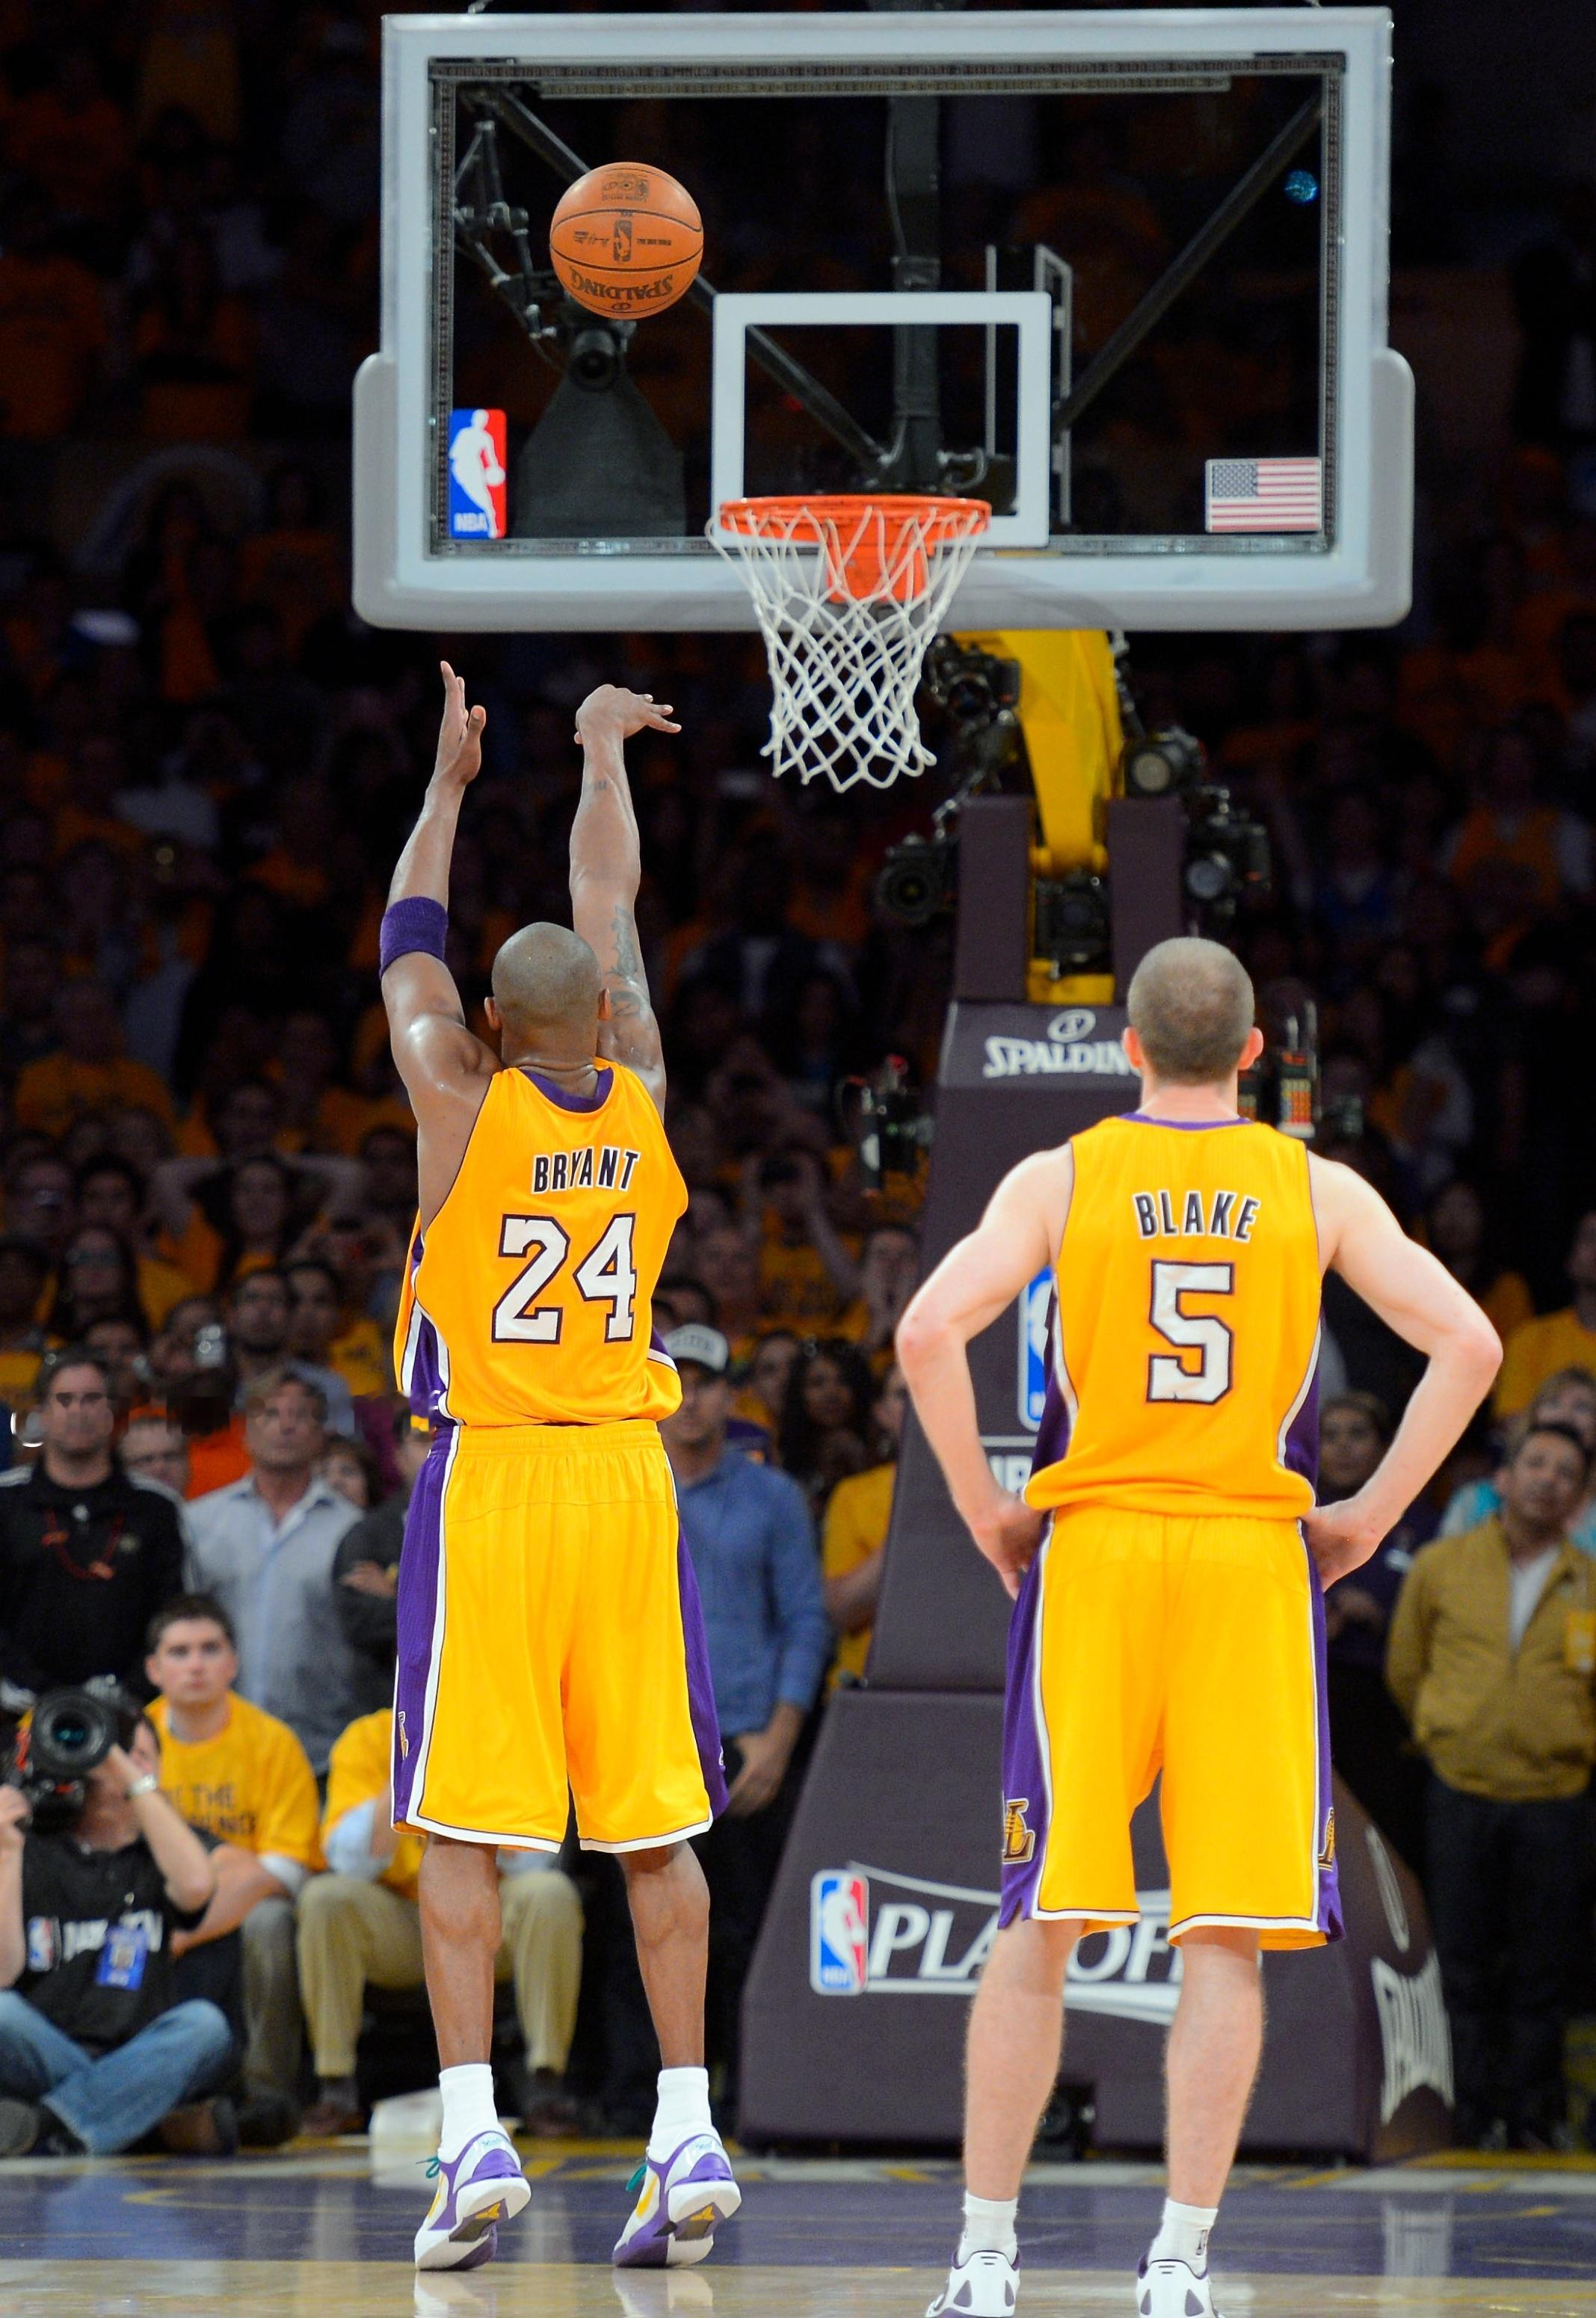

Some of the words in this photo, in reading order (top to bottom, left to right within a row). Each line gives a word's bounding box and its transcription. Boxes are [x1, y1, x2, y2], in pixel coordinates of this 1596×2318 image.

[570, 266, 674, 300] SPALDING
[454, 512, 488, 532] NBA
[983, 1036, 1141, 1078] SPALDIN
[532, 1146, 641, 1194] BRYANT
[1133, 1190, 1261, 1243] BLAKE
[491, 1212, 637, 1344] 24
[1146, 1258, 1235, 1405] 5
[869, 1903, 1263, 1983] PLAOF
